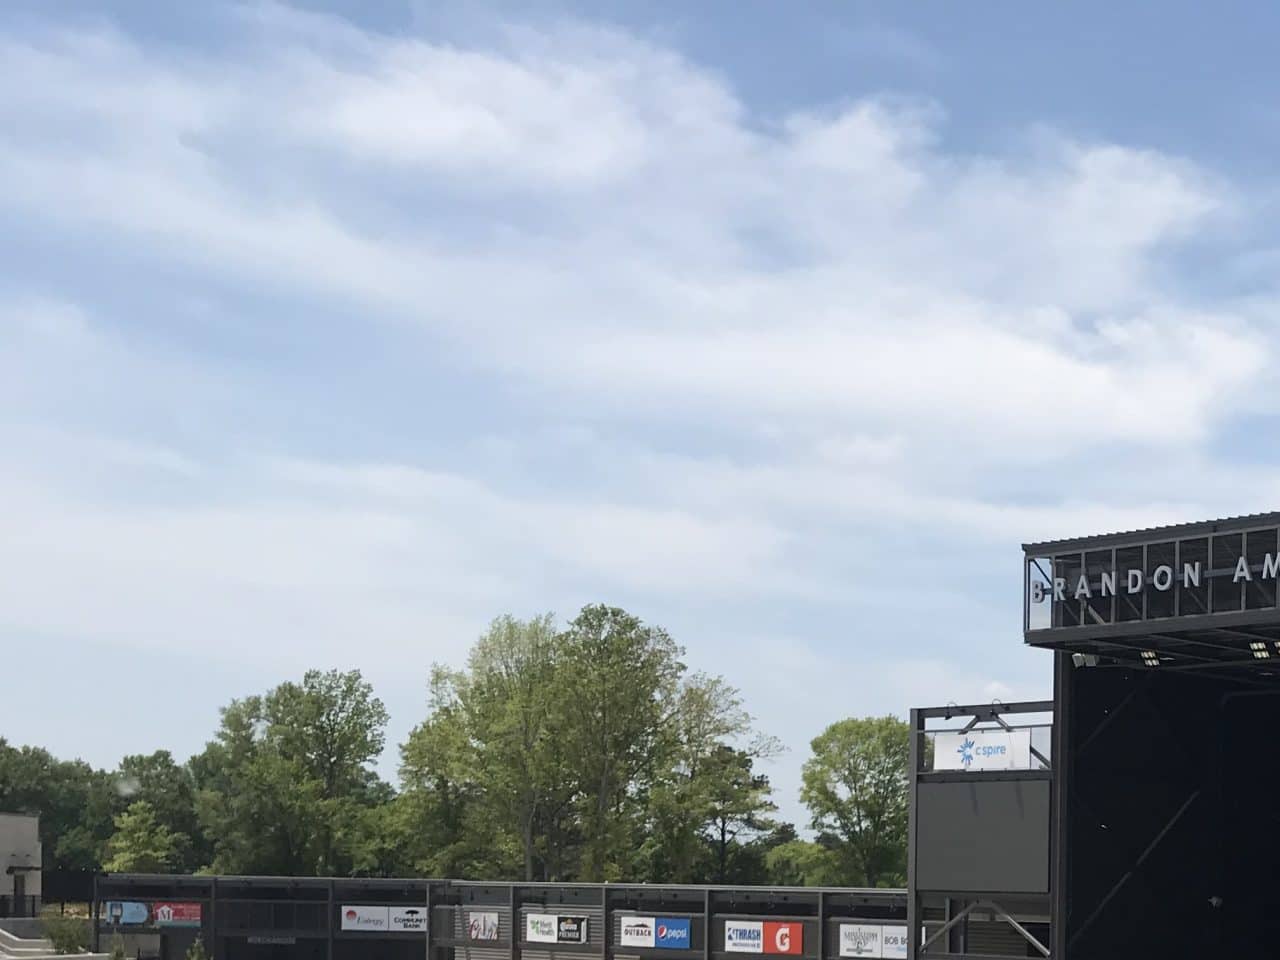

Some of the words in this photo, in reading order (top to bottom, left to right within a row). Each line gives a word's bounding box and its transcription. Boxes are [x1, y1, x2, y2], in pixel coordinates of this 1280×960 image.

[1032, 562, 1200, 603] BRANDON
[624, 928, 651, 937] OUTBACK
[667, 928, 687, 939] pepsi
[735, 927, 761, 940] THRASH
[775, 927, 790, 952] G
[884, 935, 899, 945] BOB
